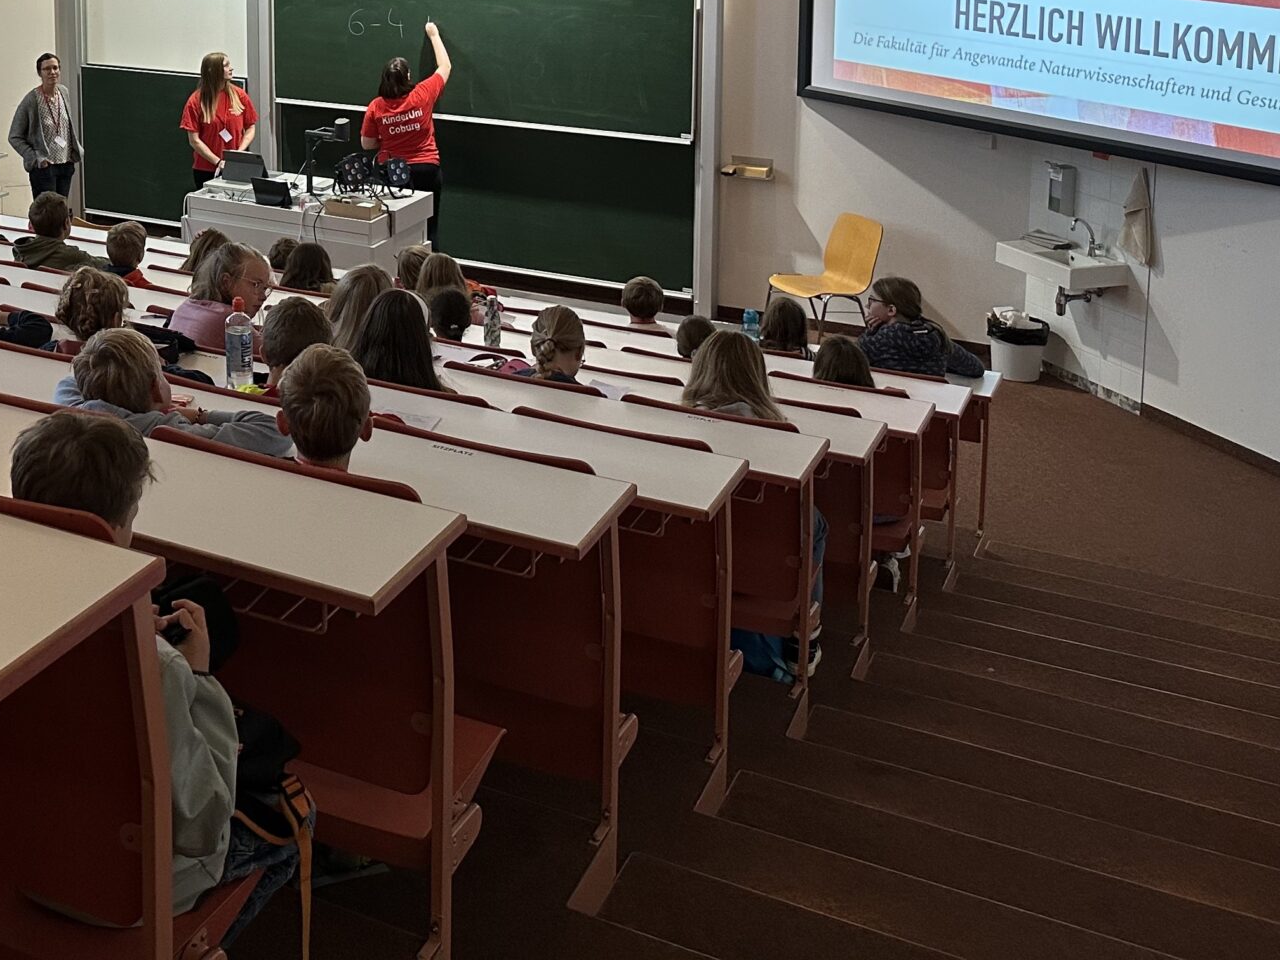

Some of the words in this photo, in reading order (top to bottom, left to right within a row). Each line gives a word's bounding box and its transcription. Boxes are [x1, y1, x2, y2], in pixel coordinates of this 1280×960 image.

[1096, 13, 1280, 75] WILLKOMM
[853, 31, 874, 47] Die
[876, 35, 928, 56] Fakultät
[928, 42, 950, 60] für
[952, 47, 1036, 72] Angewandte
[1039, 59, 1195, 97] Naturwissenschaften
[1200, 86, 1232, 103] und
[1237, 90, 1280, 111] Gesu
[382, 108, 423, 125] KinderUni
[389, 122, 420, 135] Coburg
[240, 343, 251, 368] ACTIVE
